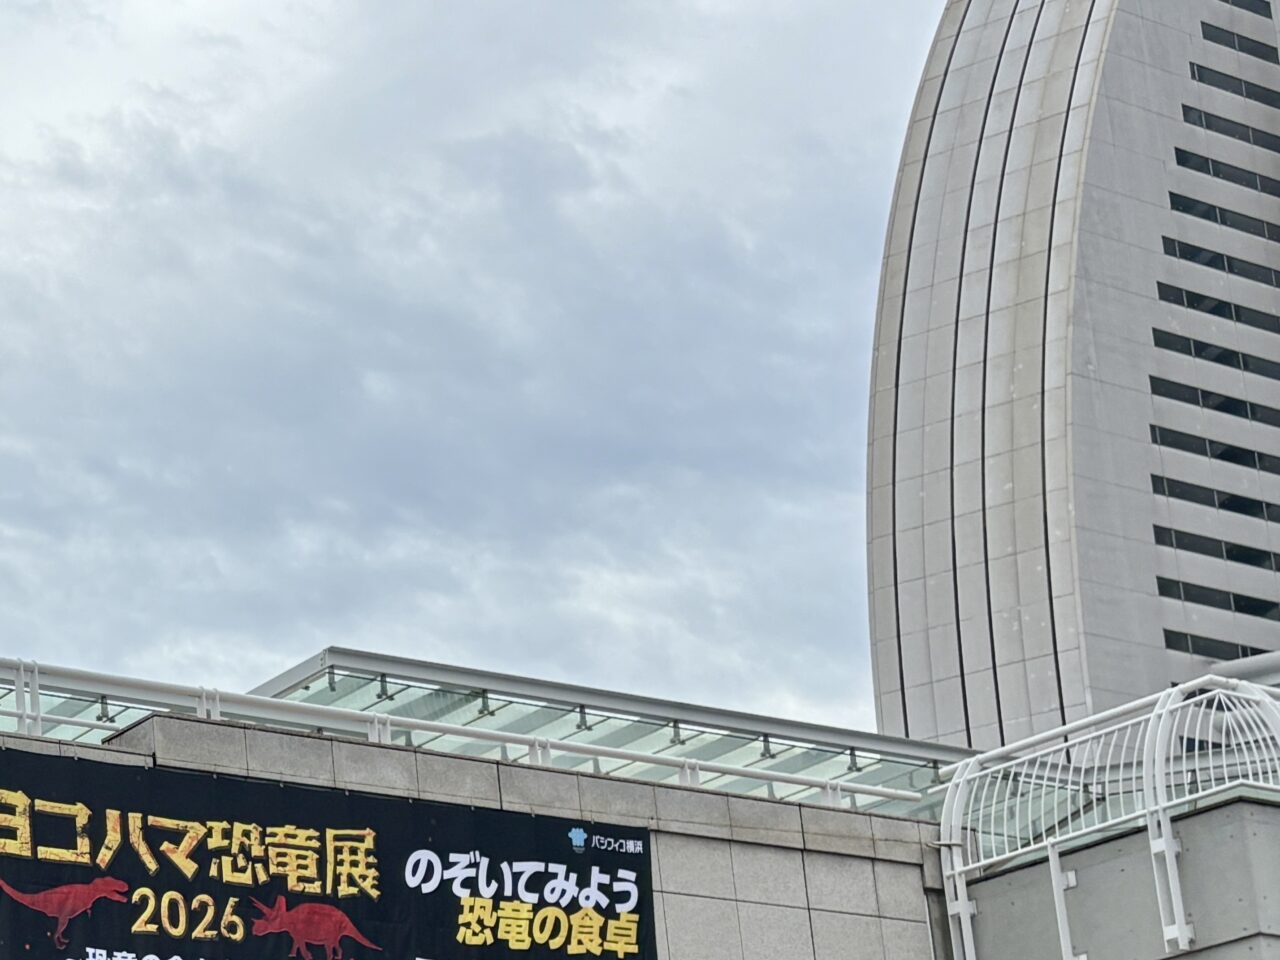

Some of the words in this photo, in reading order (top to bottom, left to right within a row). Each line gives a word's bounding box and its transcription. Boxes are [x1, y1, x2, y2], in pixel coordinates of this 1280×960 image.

[405, 849, 639, 912] のぞいてみよう
[131, 887, 245, 942] 2026
[456, 897, 640, 959] 恐竜の食卓
